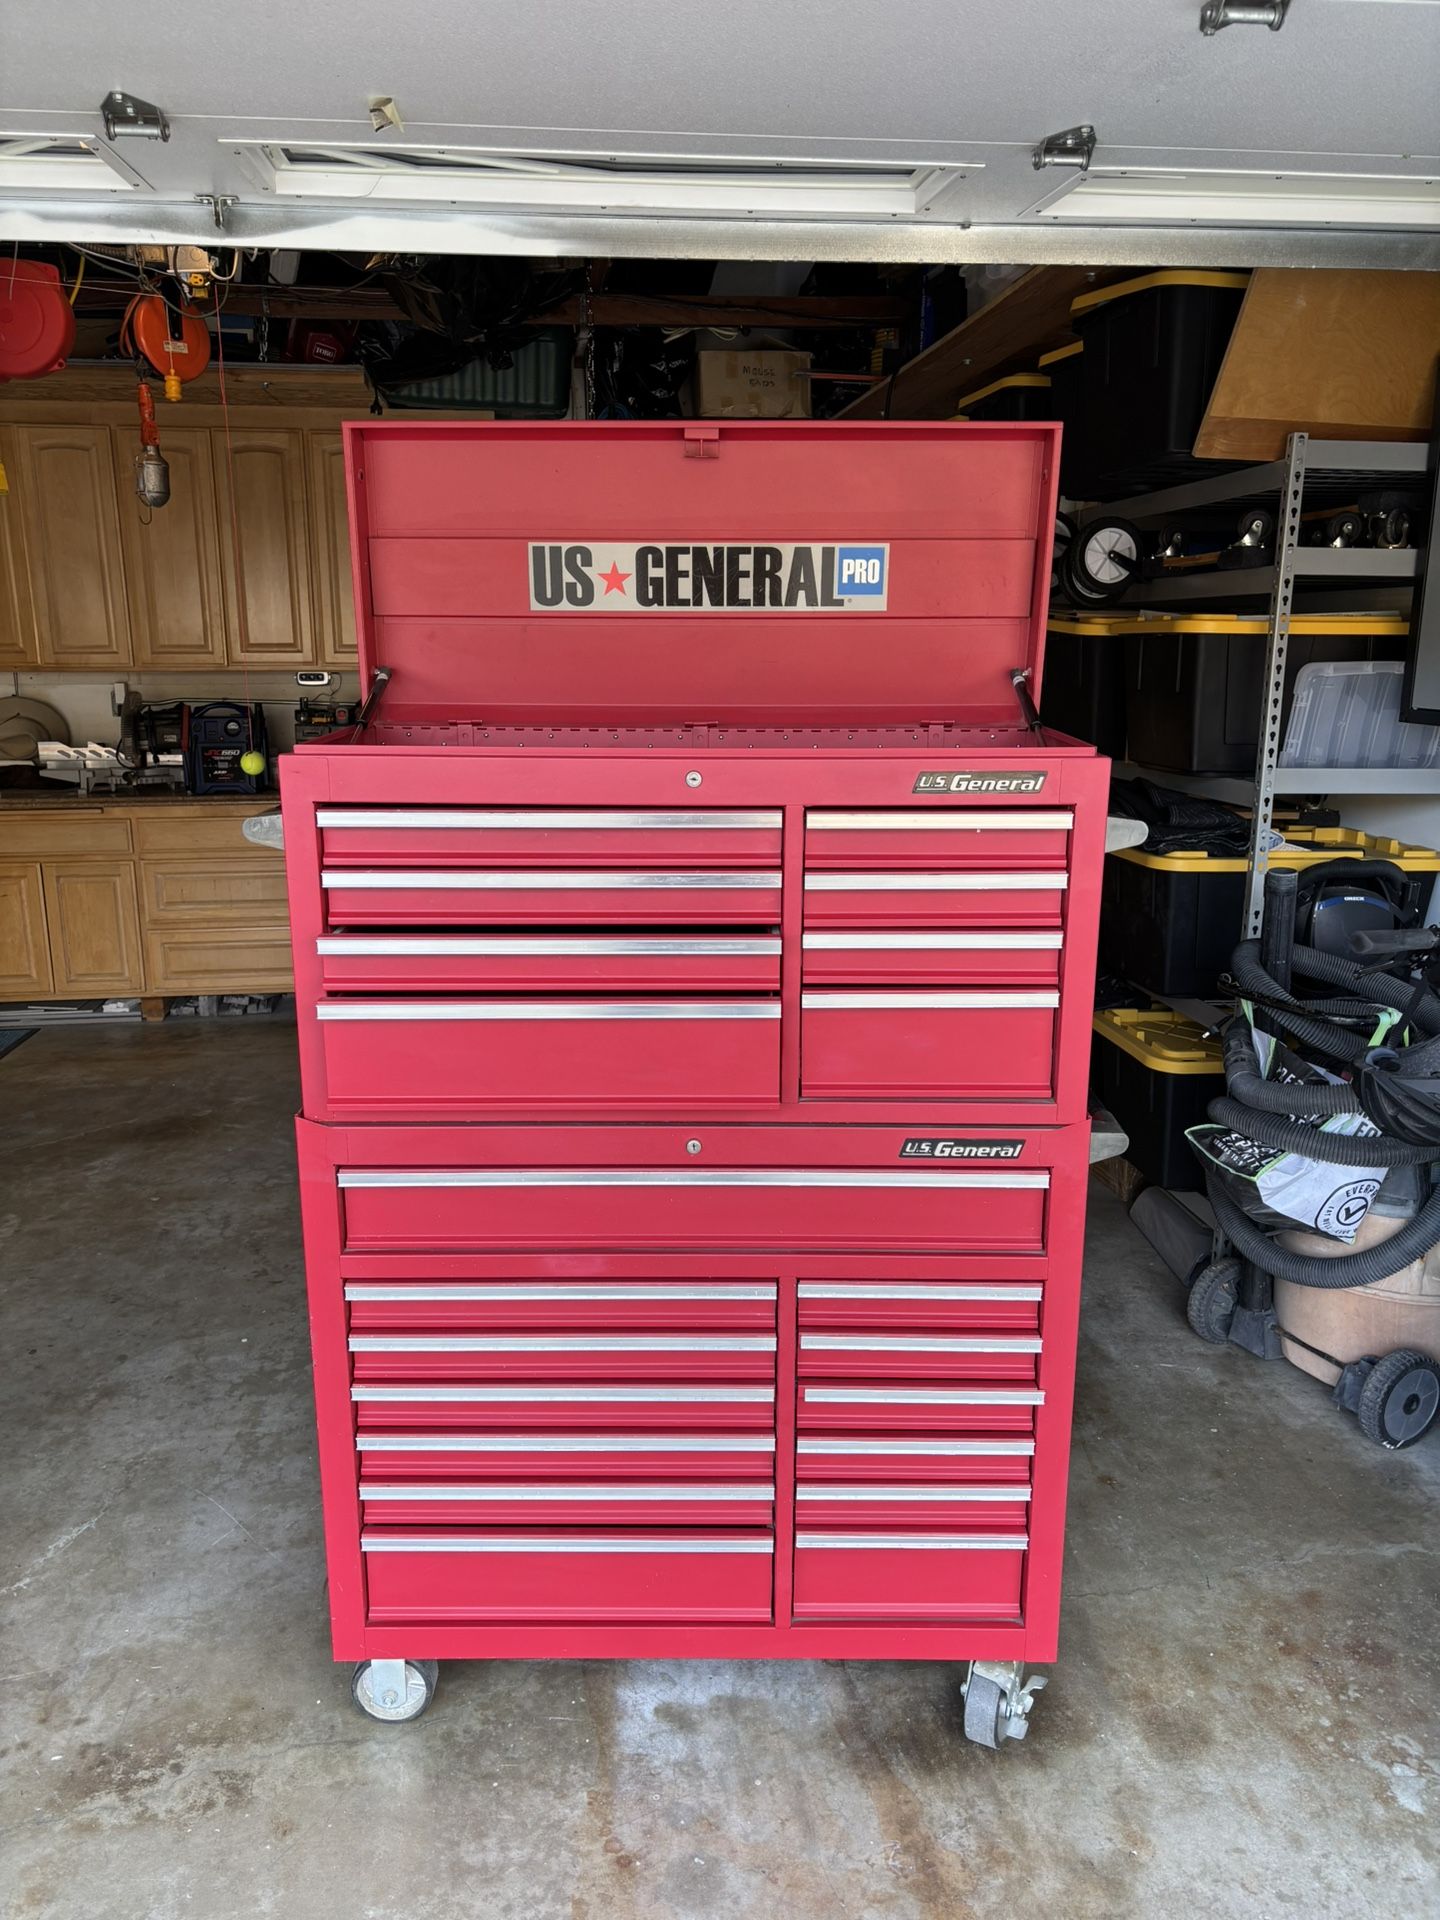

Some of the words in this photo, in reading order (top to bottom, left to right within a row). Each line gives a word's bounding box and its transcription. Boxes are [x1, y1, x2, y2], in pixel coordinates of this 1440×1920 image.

[532, 545, 594, 607] US
[635, 545, 844, 607] GENERAL
[842, 558, 880, 584] PRO
[919, 776, 948, 788] U.S.
[950, 774, 1044, 791] General
[905, 1142, 932, 1153] U.S.
[934, 1141, 1023, 1157] General
